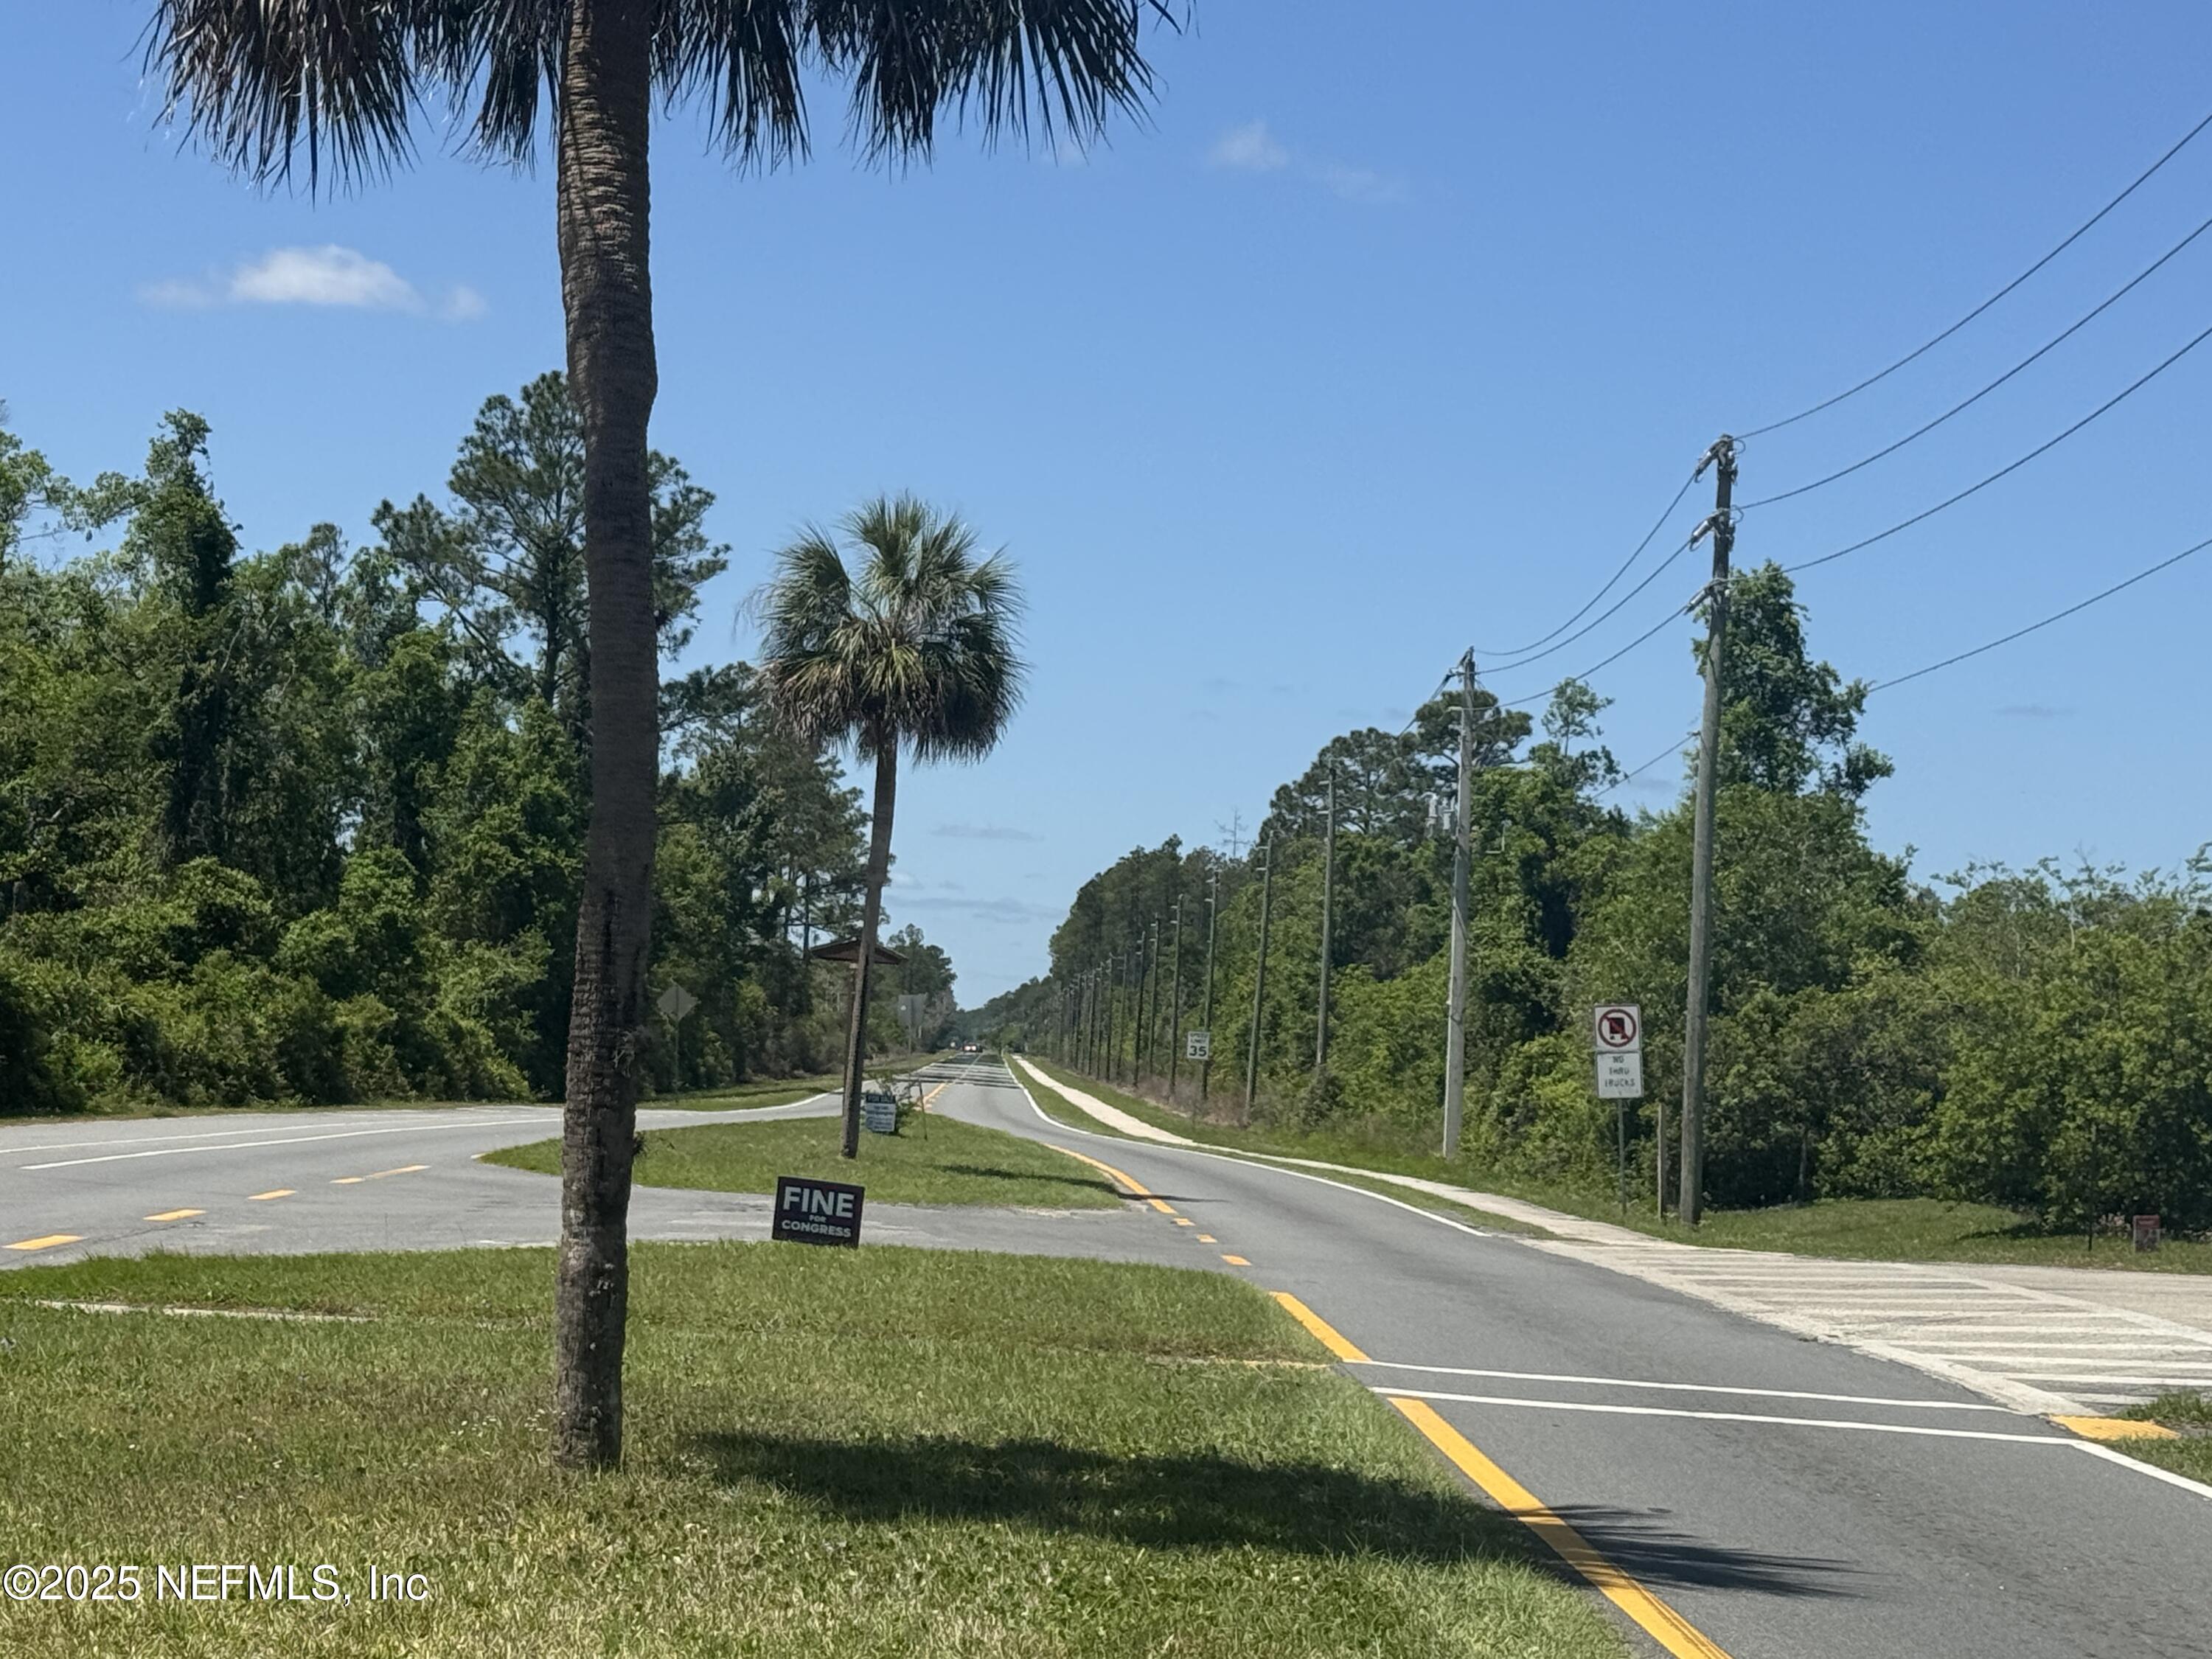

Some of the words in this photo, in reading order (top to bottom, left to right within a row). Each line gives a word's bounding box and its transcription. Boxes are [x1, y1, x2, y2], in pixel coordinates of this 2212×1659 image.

[1189, 1045, 1208, 1057] 35
[1612, 1055, 1625, 1064] NO
[1609, 1067, 1630, 1076] THRU
[1604, 1078, 1636, 1088] TRUCKS
[783, 1186, 855, 1218] FINE
[809, 1214, 827, 1223] FOR
[782, 1220, 852, 1238] CONGRESS
